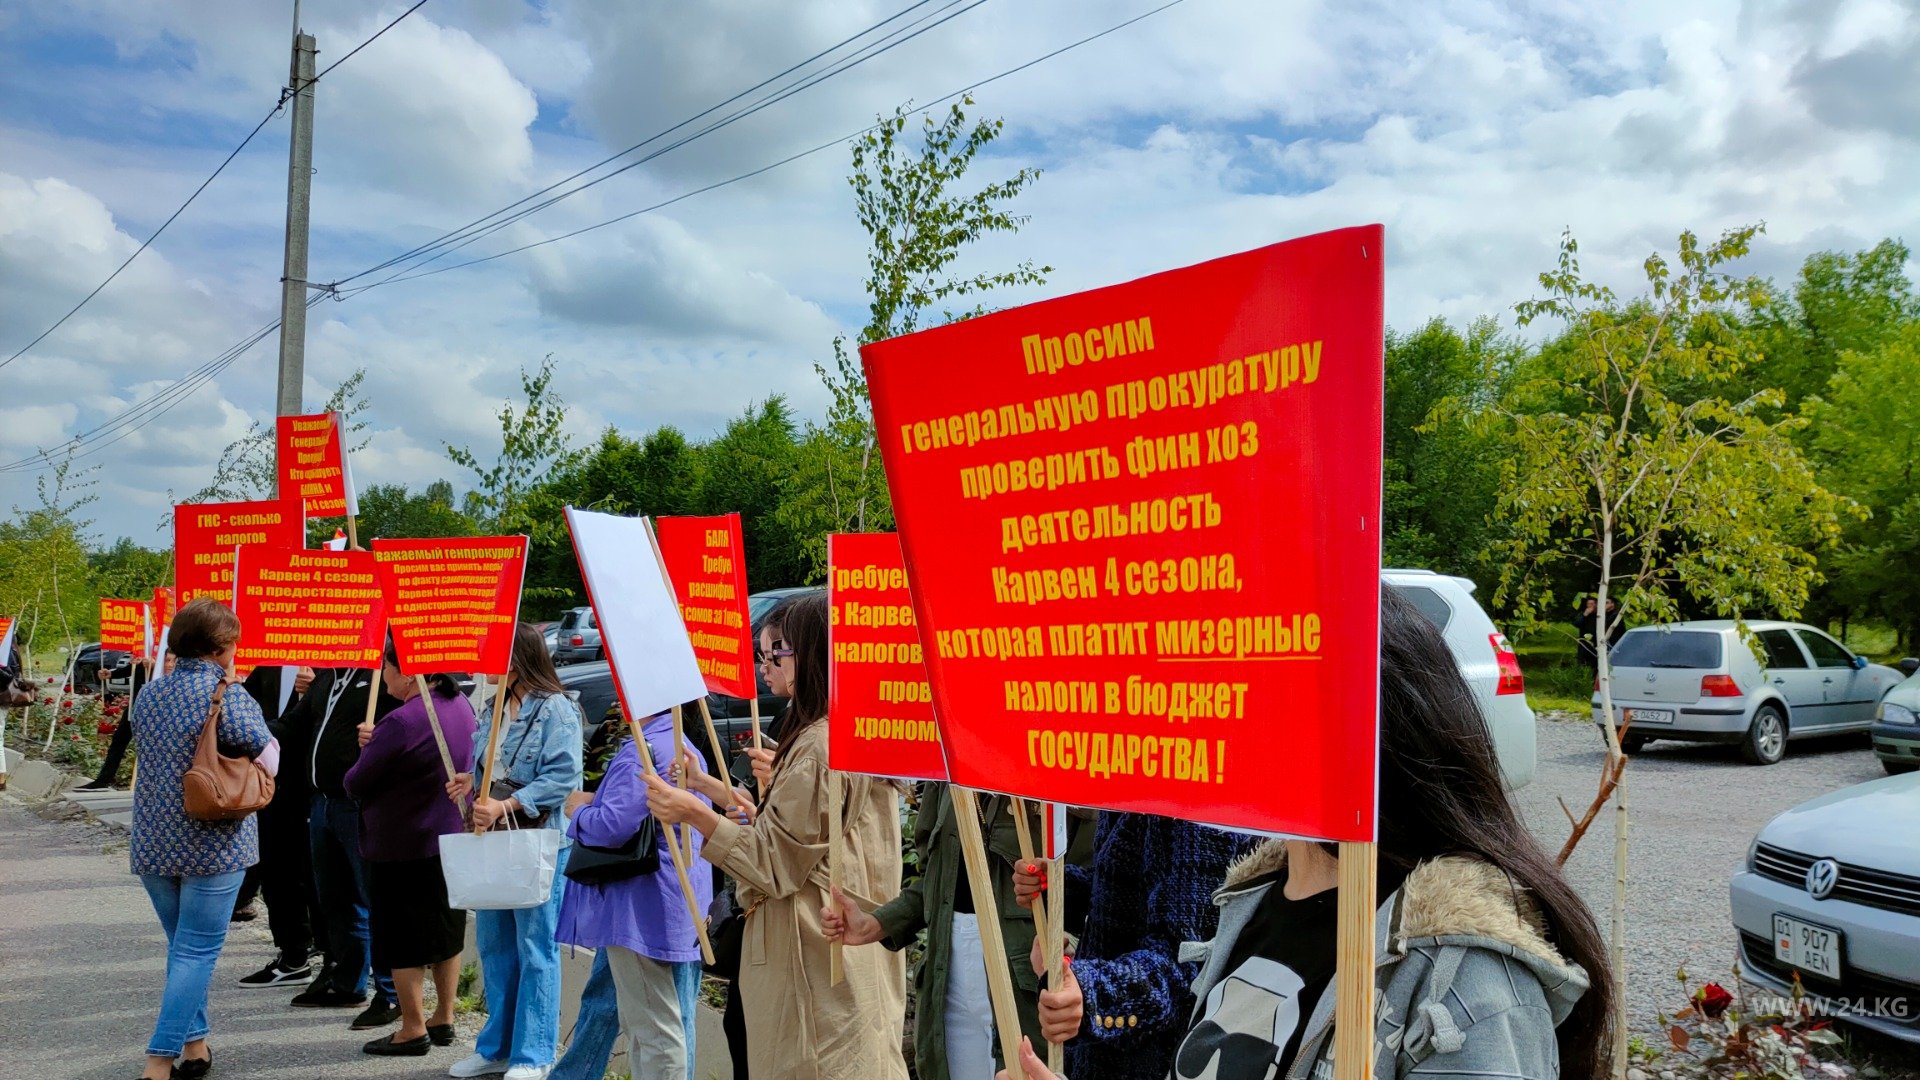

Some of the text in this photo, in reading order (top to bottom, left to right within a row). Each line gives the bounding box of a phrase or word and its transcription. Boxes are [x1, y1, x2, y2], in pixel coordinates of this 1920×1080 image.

[1021, 316, 1155, 376] Просим
[901, 340, 1324, 454] генеральную прокуратуру
[960, 420, 1259, 500] проверить фин хоз
[312, 499, 319, 510] 4
[197, 514, 221, 528] ГНС
[229, 513, 282, 527] сколько
[1001, 492, 1222, 554] деятельность
[215, 532, 267, 545] налогов
[289, 554, 348, 568] Договор
[374, 547, 443, 563] важаемый
[445, 546, 514, 560] генпрокурор
[259, 568, 374, 584] Карвен 4 сезона
[393, 564, 429, 575] Просим
[430, 563, 446, 572] вас
[447, 562, 482, 573] принять
[210, 571, 218, 583] в
[398, 577, 410, 586] по
[411, 575, 440, 587] факту
[992, 553, 1243, 606] Карвен 4 сезона,
[246, 585, 383, 599] на предоставление
[398, 589, 433, 600] Карвен
[433, 588, 439, 597] 4
[101, 601, 137, 623] Бал
[259, 601, 298, 613] услуг
[308, 603, 371, 614] является
[395, 604, 402, 613] в
[685, 606, 714, 625] сомов
[713, 609, 723, 625] за
[845, 601, 917, 629] Карве
[264, 617, 364, 629] незаконным и
[452, 614, 459, 623] и
[265, 632, 361, 645] противоречит
[936, 612, 1322, 661] которая платит мизерные
[413, 641, 421, 650] и
[834, 641, 924, 665] налогов
[236, 648, 381, 661] законодательству КР
[710, 657, 716, 676] 4
[879, 680, 933, 704] пров
[1004, 675, 1249, 724] налоги в бюджет
[1640, 711, 1661, 721] 0452
[1027, 729, 1210, 783] ГОСУДАРСТВА
[1802, 927, 1829, 953] 907
[1805, 950, 1830, 973] AEN
